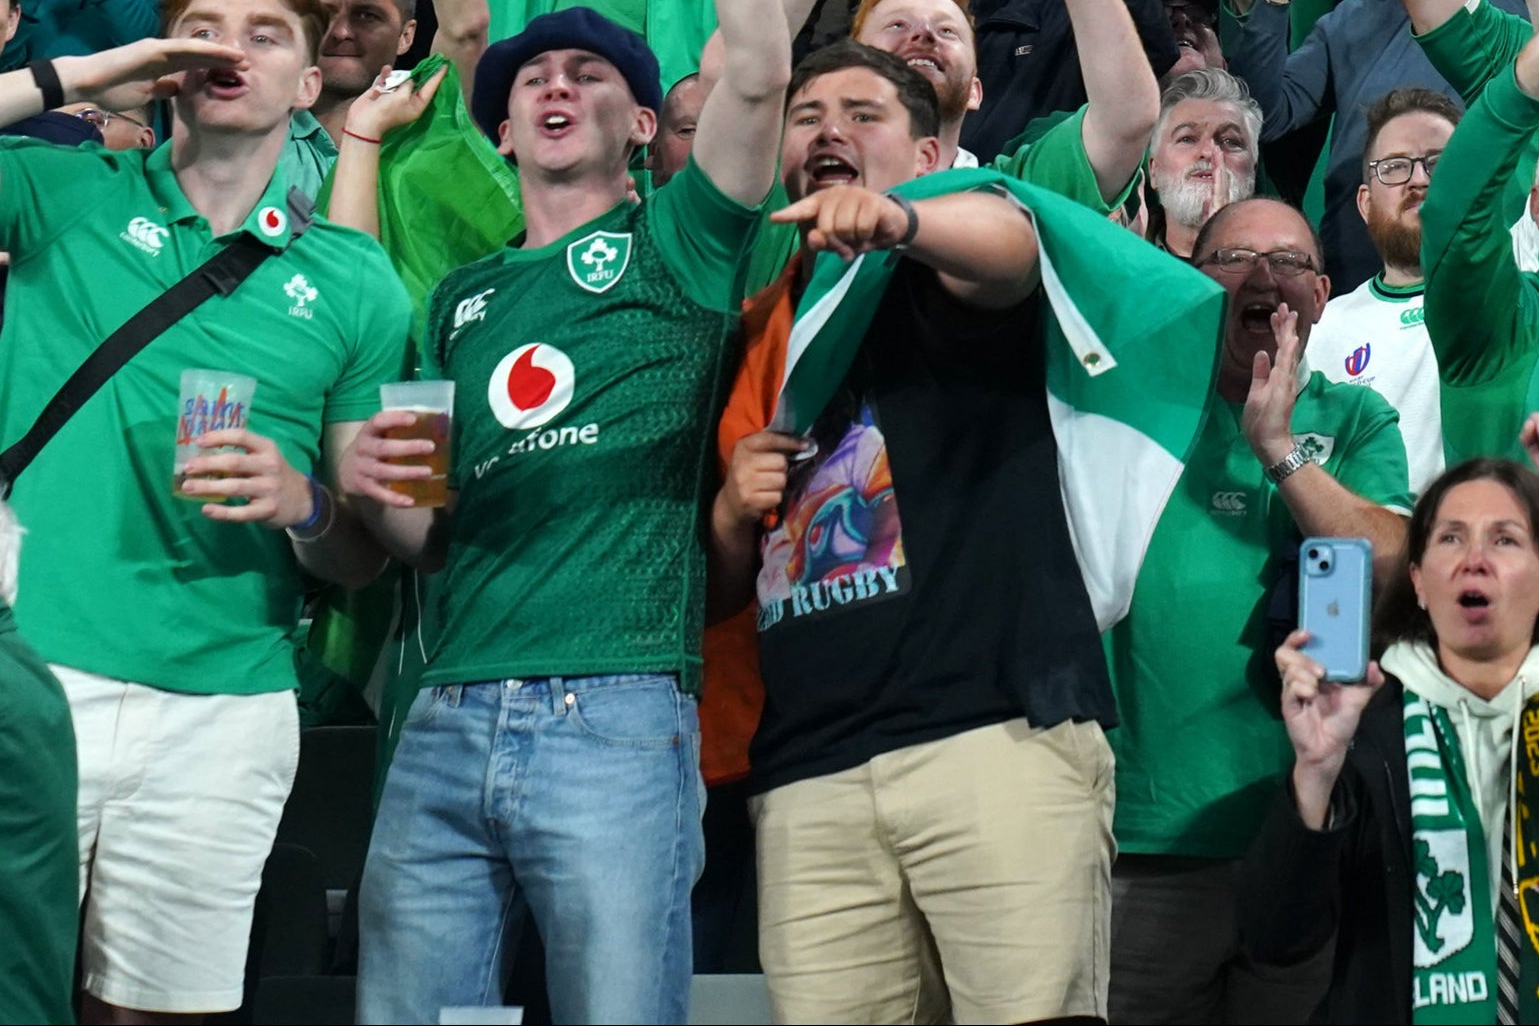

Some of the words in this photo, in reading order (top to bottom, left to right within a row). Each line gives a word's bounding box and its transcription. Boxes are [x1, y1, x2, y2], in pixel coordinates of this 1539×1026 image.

[587, 270, 614, 284] IRFU
[288, 306, 314, 320] IRFU
[791, 567, 900, 617] RUGBY
[1413, 971, 1488, 1008] LAND
